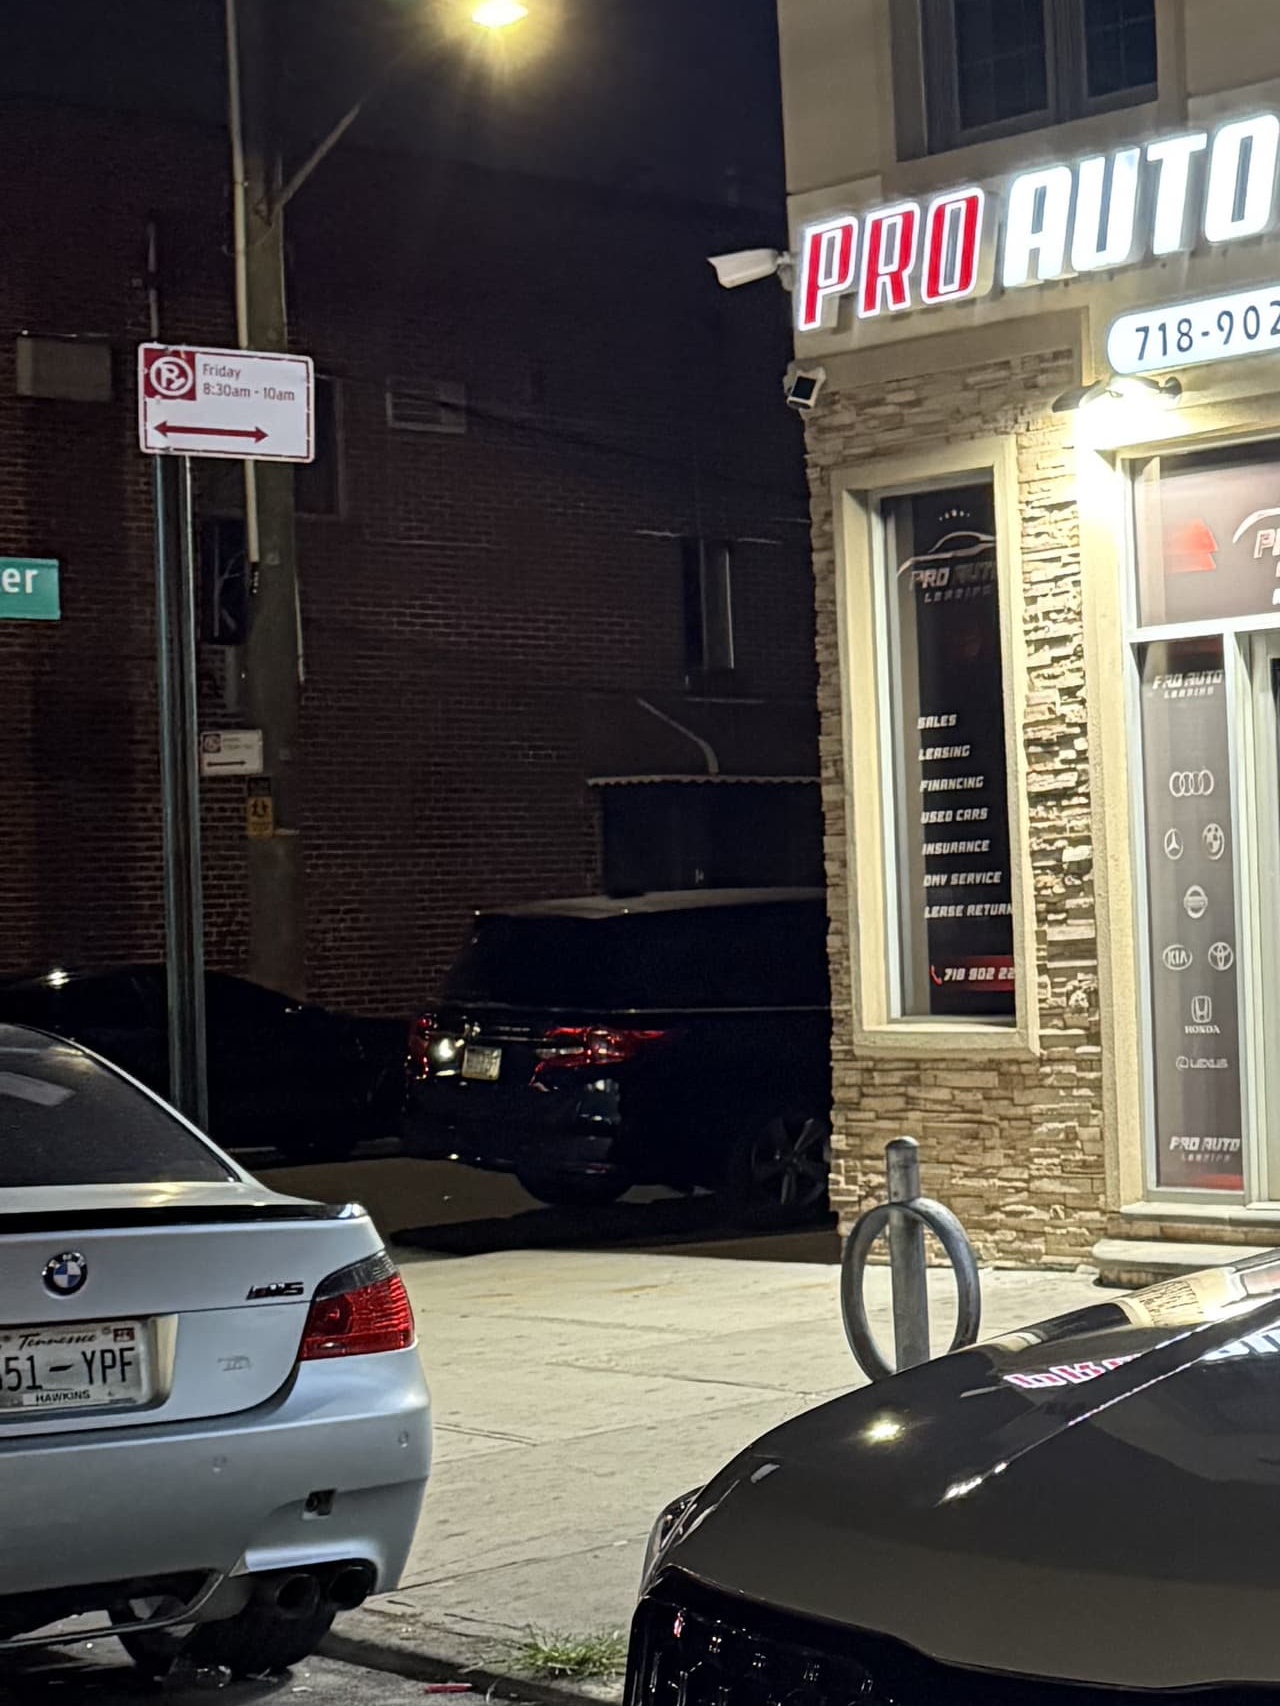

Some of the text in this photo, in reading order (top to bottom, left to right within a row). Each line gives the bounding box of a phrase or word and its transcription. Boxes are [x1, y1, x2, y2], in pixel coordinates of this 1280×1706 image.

[798, 187, 984, 332] PRO
[202, 363, 241, 379] Friday
[203, 382, 251, 398] 8:30am
[263, 387, 295, 401] 10am
[2, 567, 39, 594] er
[909, 568, 950, 592] PRO
[917, 714, 957, 730] SALES
[918, 745, 971, 761] LEASING
[920, 776, 984, 793] FINANCING
[920, 807, 989, 825] USED CARS
[922, 840, 990, 855] INSURANCE
[923, 871, 1002, 887] DMV SERVICE
[924, 905, 964, 918] LEASE
[944, 967, 1015, 981] 718 902 22
[1185, 1024, 1221, 1034] HONDA
[1189, 1057, 1229, 1069] LEXUS
[1169, 1136, 1241, 1151] PRO AUTO
[18, 1332, 98, 1351] Tennessee
[0, 1346, 136, 1391] 51 YPF
[35, 1390, 90, 1404] HAWKINS
